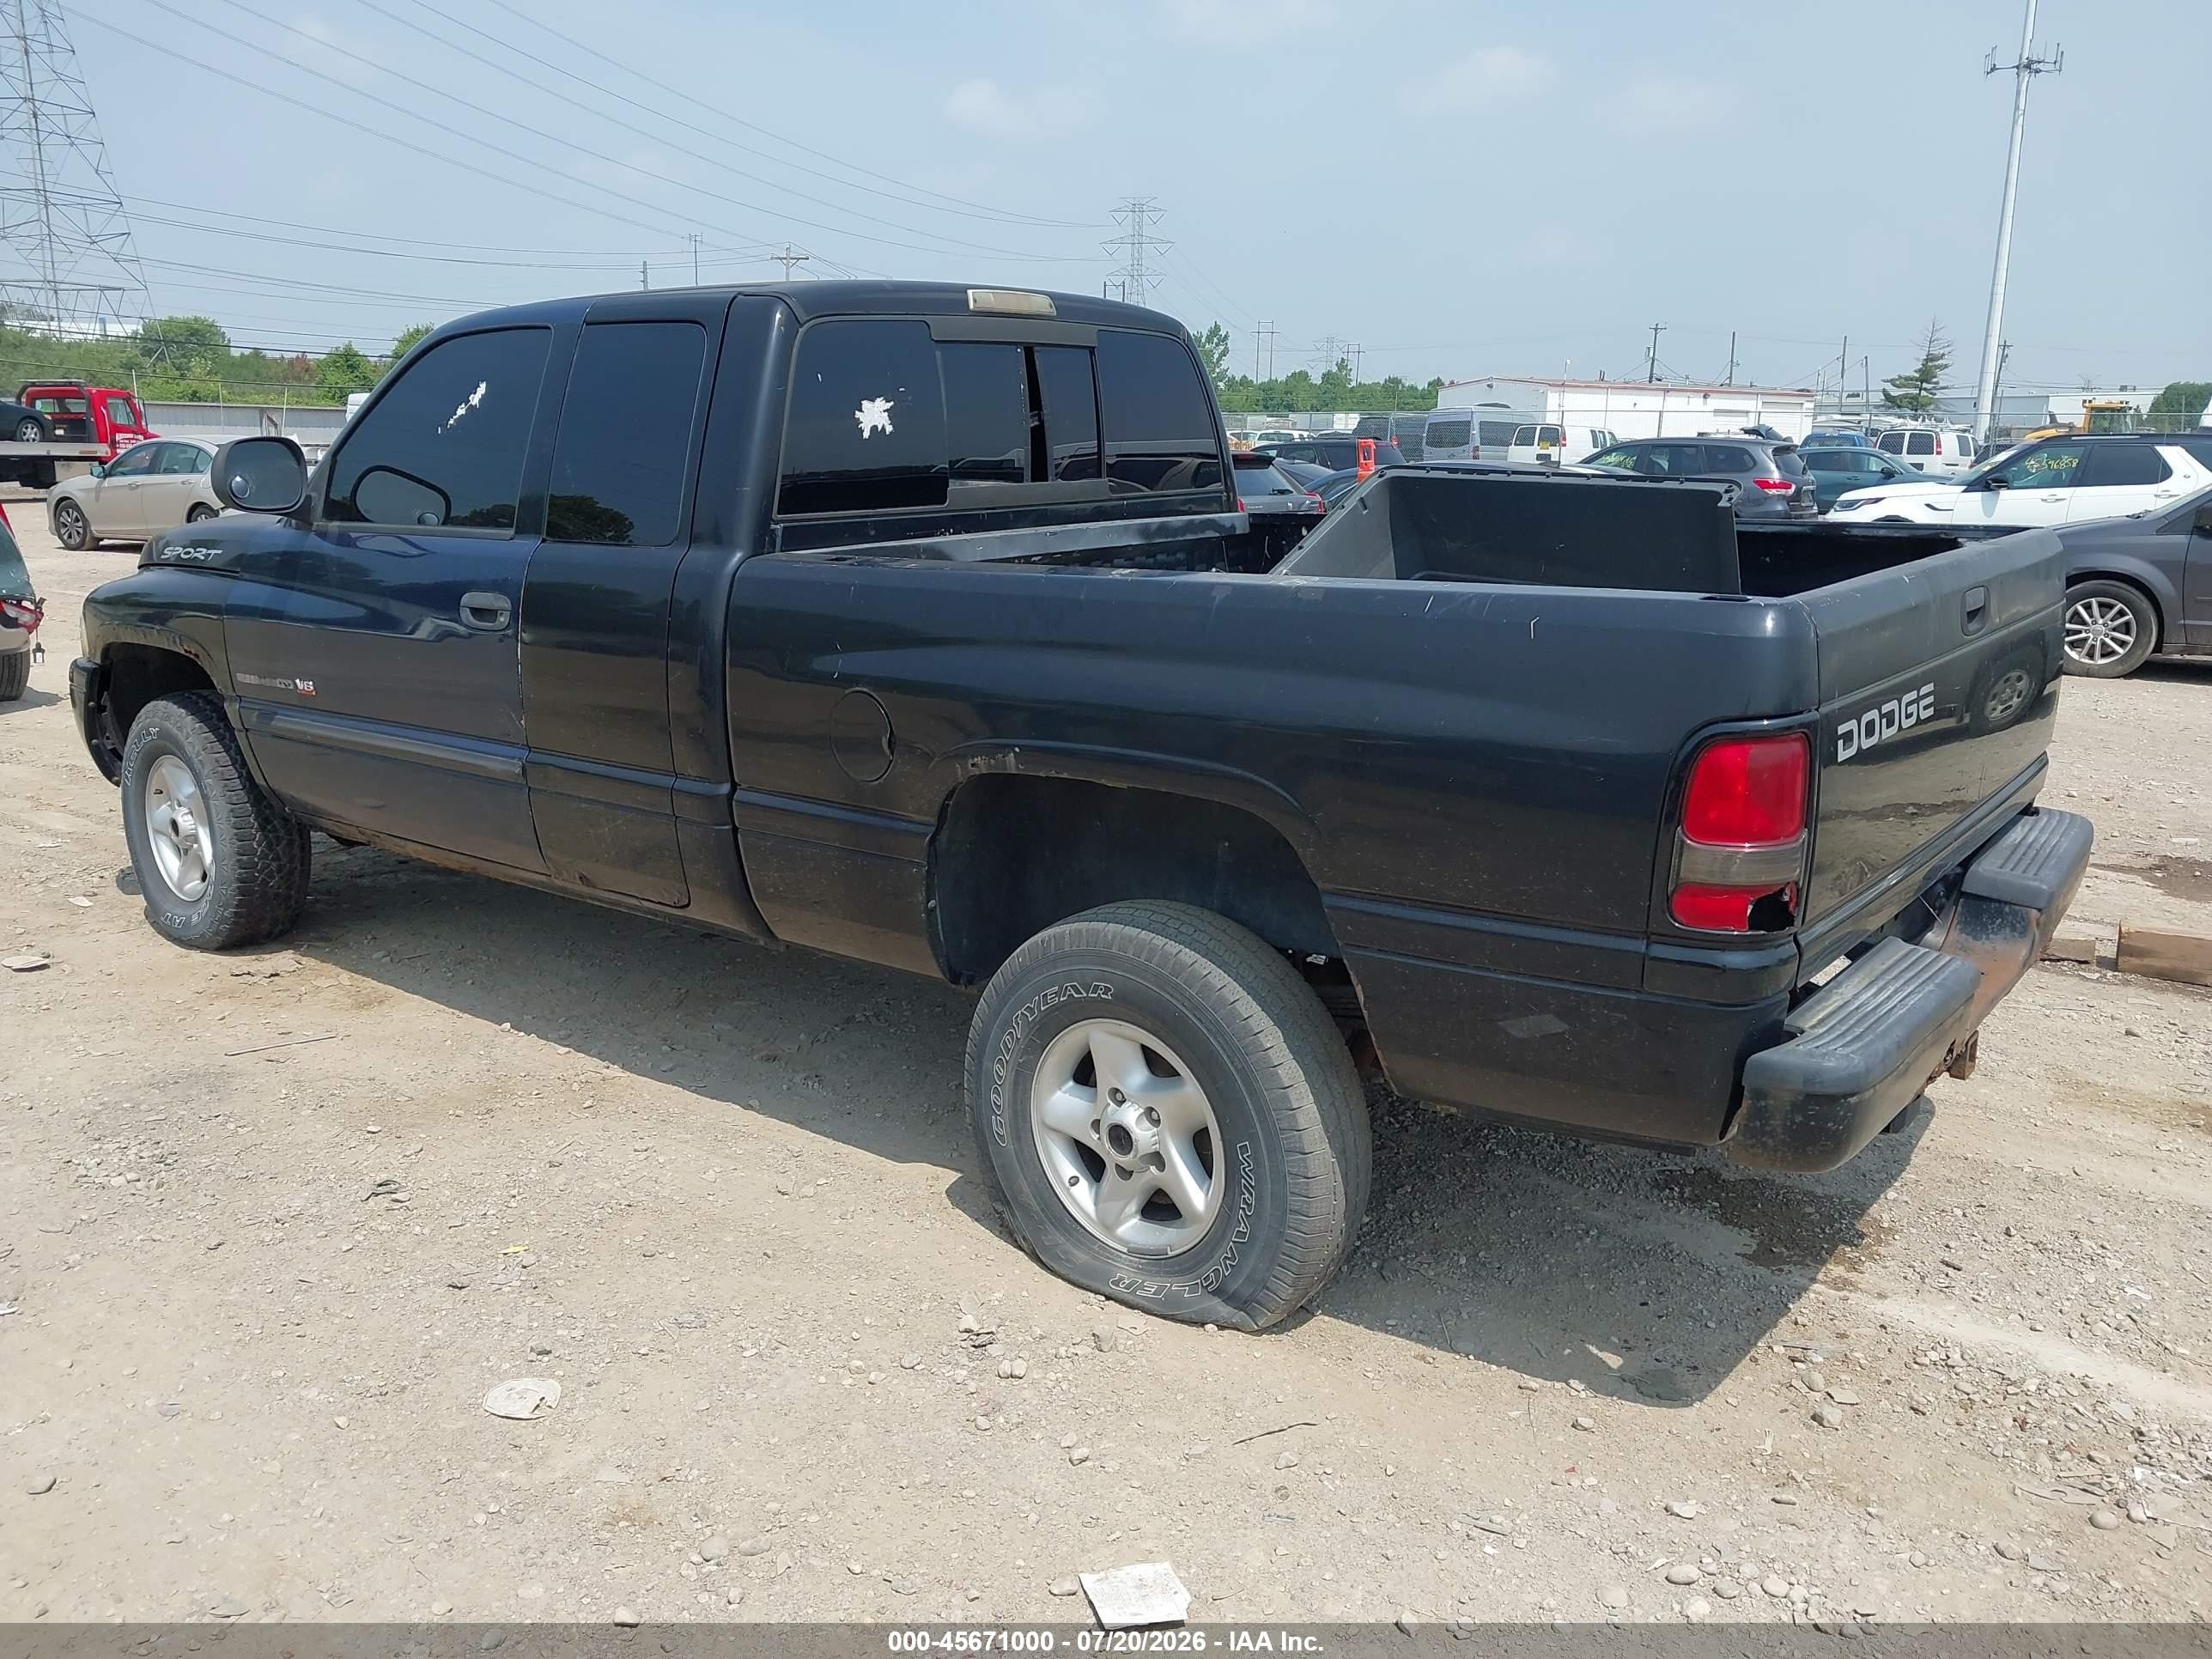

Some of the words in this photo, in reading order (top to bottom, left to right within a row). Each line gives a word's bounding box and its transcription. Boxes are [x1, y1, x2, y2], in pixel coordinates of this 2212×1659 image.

[161, 546, 223, 562] SPORT
[1838, 682, 1935, 763] DODGE
[991, 981, 1114, 1148] GOODYEAR
[1109, 1141, 1256, 1298] WRANGLER
